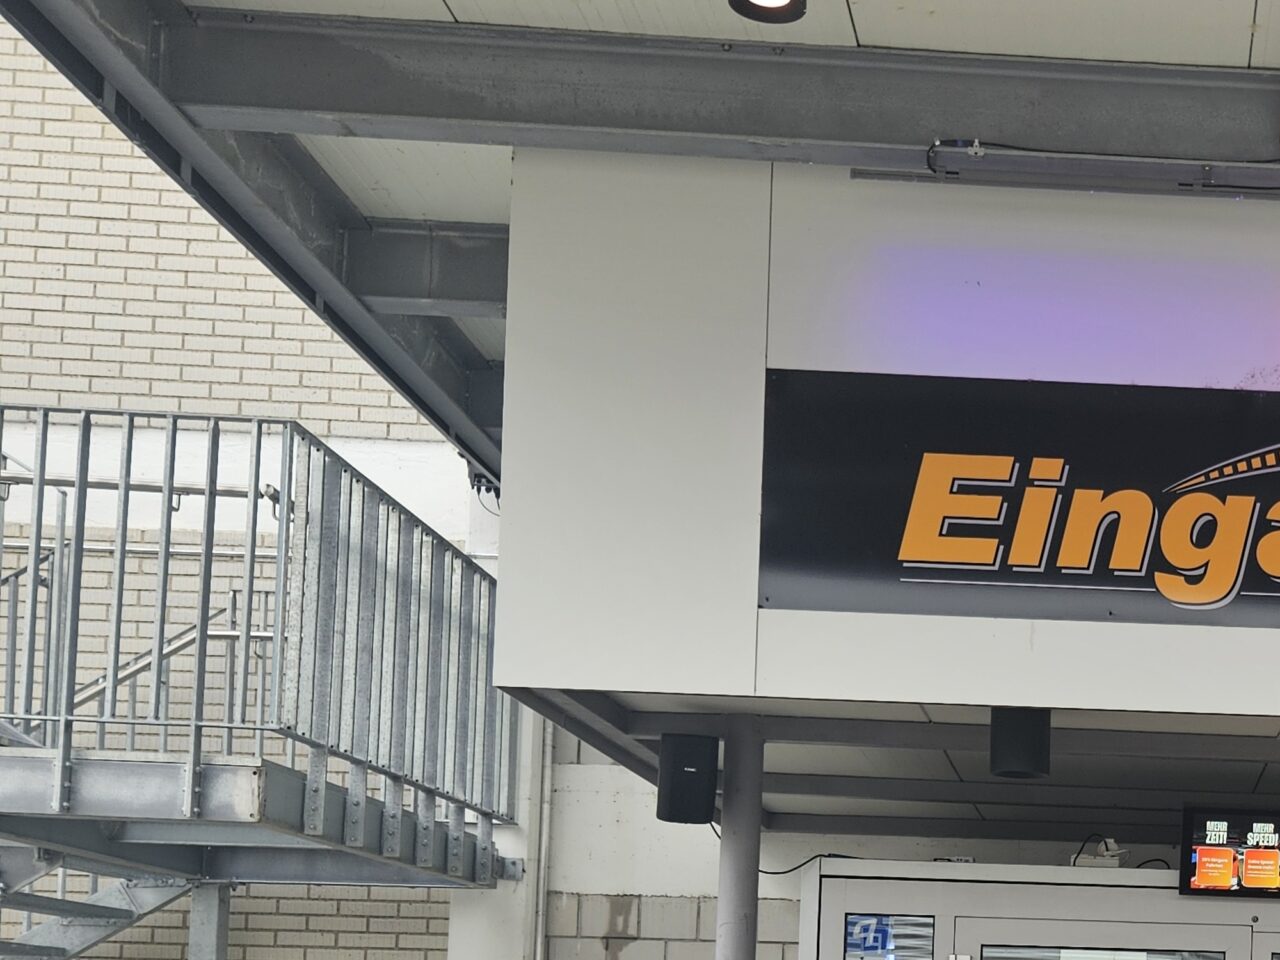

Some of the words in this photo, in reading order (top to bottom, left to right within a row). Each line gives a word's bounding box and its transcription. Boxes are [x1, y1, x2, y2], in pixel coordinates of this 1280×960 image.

[1206, 821, 1228, 831] MEHR
[1252, 823, 1275, 833] MEHR
[1205, 831, 1228, 844] ZEIT!
[1246, 832, 1279, 847] SPEED!
